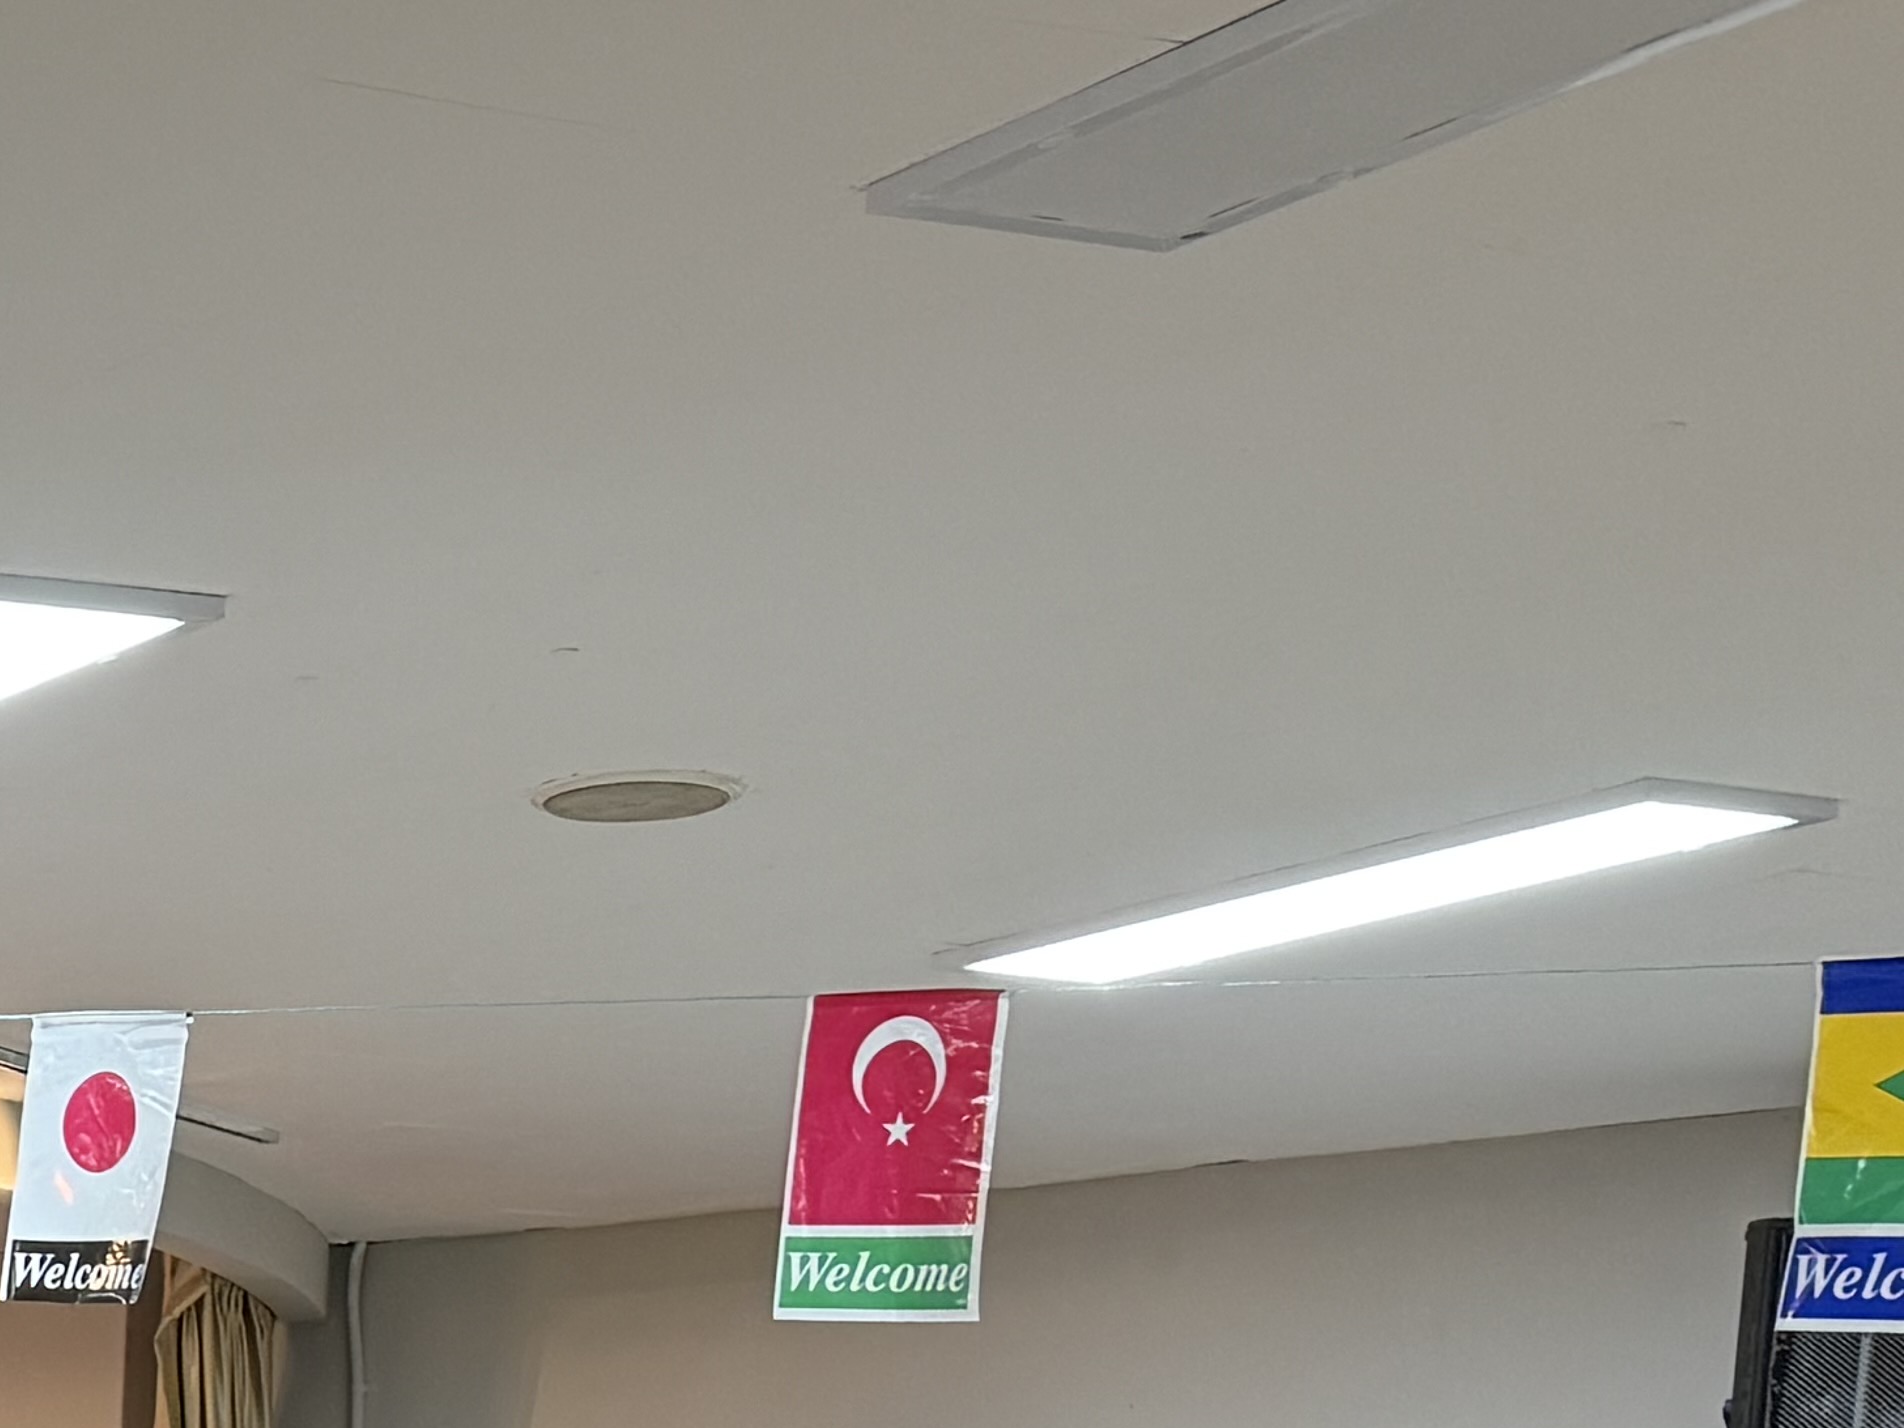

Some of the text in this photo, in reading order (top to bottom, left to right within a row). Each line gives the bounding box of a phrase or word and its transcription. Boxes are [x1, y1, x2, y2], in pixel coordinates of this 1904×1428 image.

[13, 1252, 145, 1291] Welcome
[787, 1250, 968, 1293] Welcome
[1795, 1252, 1904, 1301] Welc
